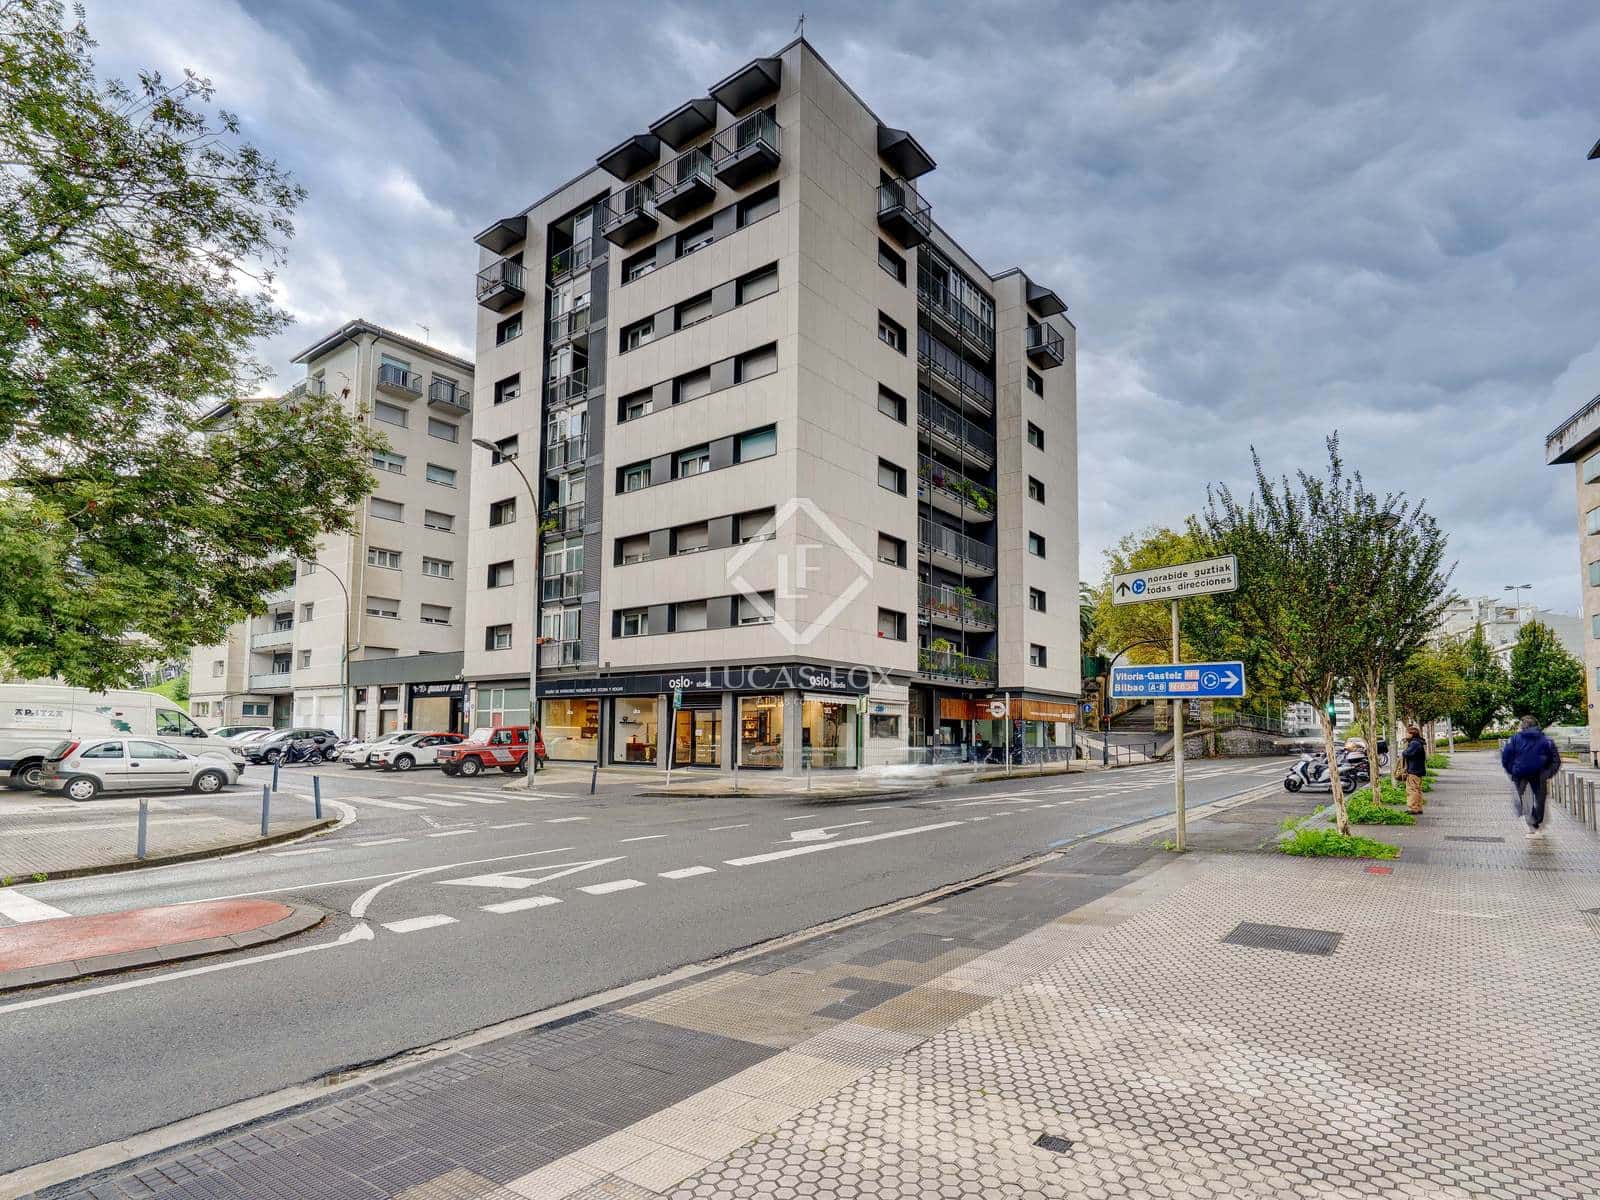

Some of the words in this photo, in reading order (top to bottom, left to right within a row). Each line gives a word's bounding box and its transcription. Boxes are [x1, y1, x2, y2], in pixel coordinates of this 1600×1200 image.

[1147, 570, 1188, 583] norabide
[1194, 563, 1231, 577] guztiak
[1147, 584, 1172, 594] todas
[1177, 576, 1232, 591] direcciones
[668, 675, 691, 688] oslo
[809, 674, 830, 688] oslo
[1115, 671, 1182, 681] Vitoria-Gasteiz
[1114, 683, 1145, 692] Bilbao
